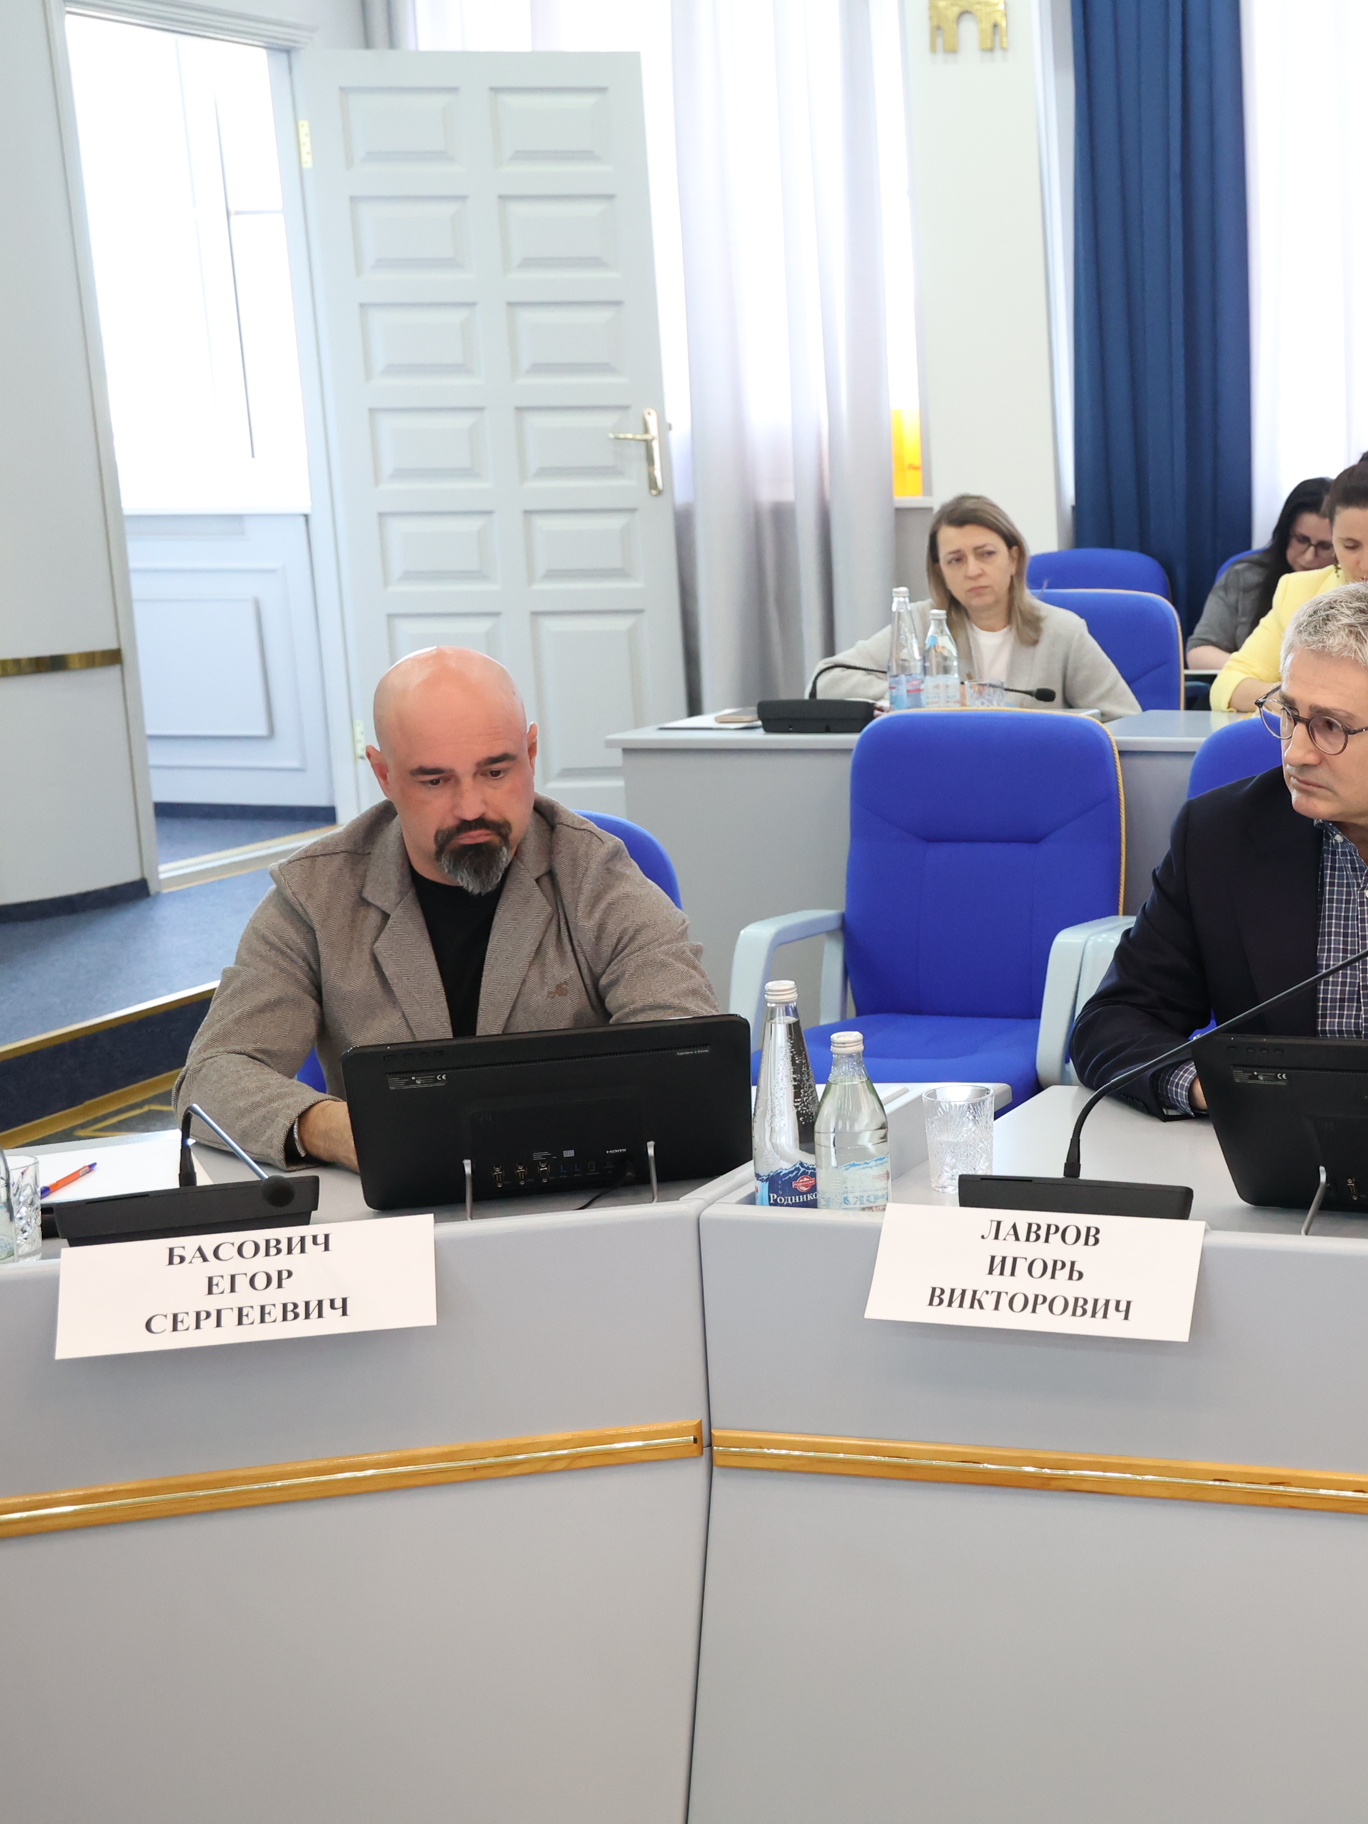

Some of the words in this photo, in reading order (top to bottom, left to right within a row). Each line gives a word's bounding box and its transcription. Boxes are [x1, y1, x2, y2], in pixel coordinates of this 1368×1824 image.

[980, 1219, 1101, 1247] ЛАВРОВ
[166, 1232, 331, 1267] БАСОВИЧ
[205, 1268, 294, 1297] ЕГОР
[985, 1254, 1085, 1282] ИГОРЬ
[143, 1296, 350, 1335] СЕРГЕЕВИЧ
[926, 1286, 1133, 1321] ВИКТОРОВИЧ
